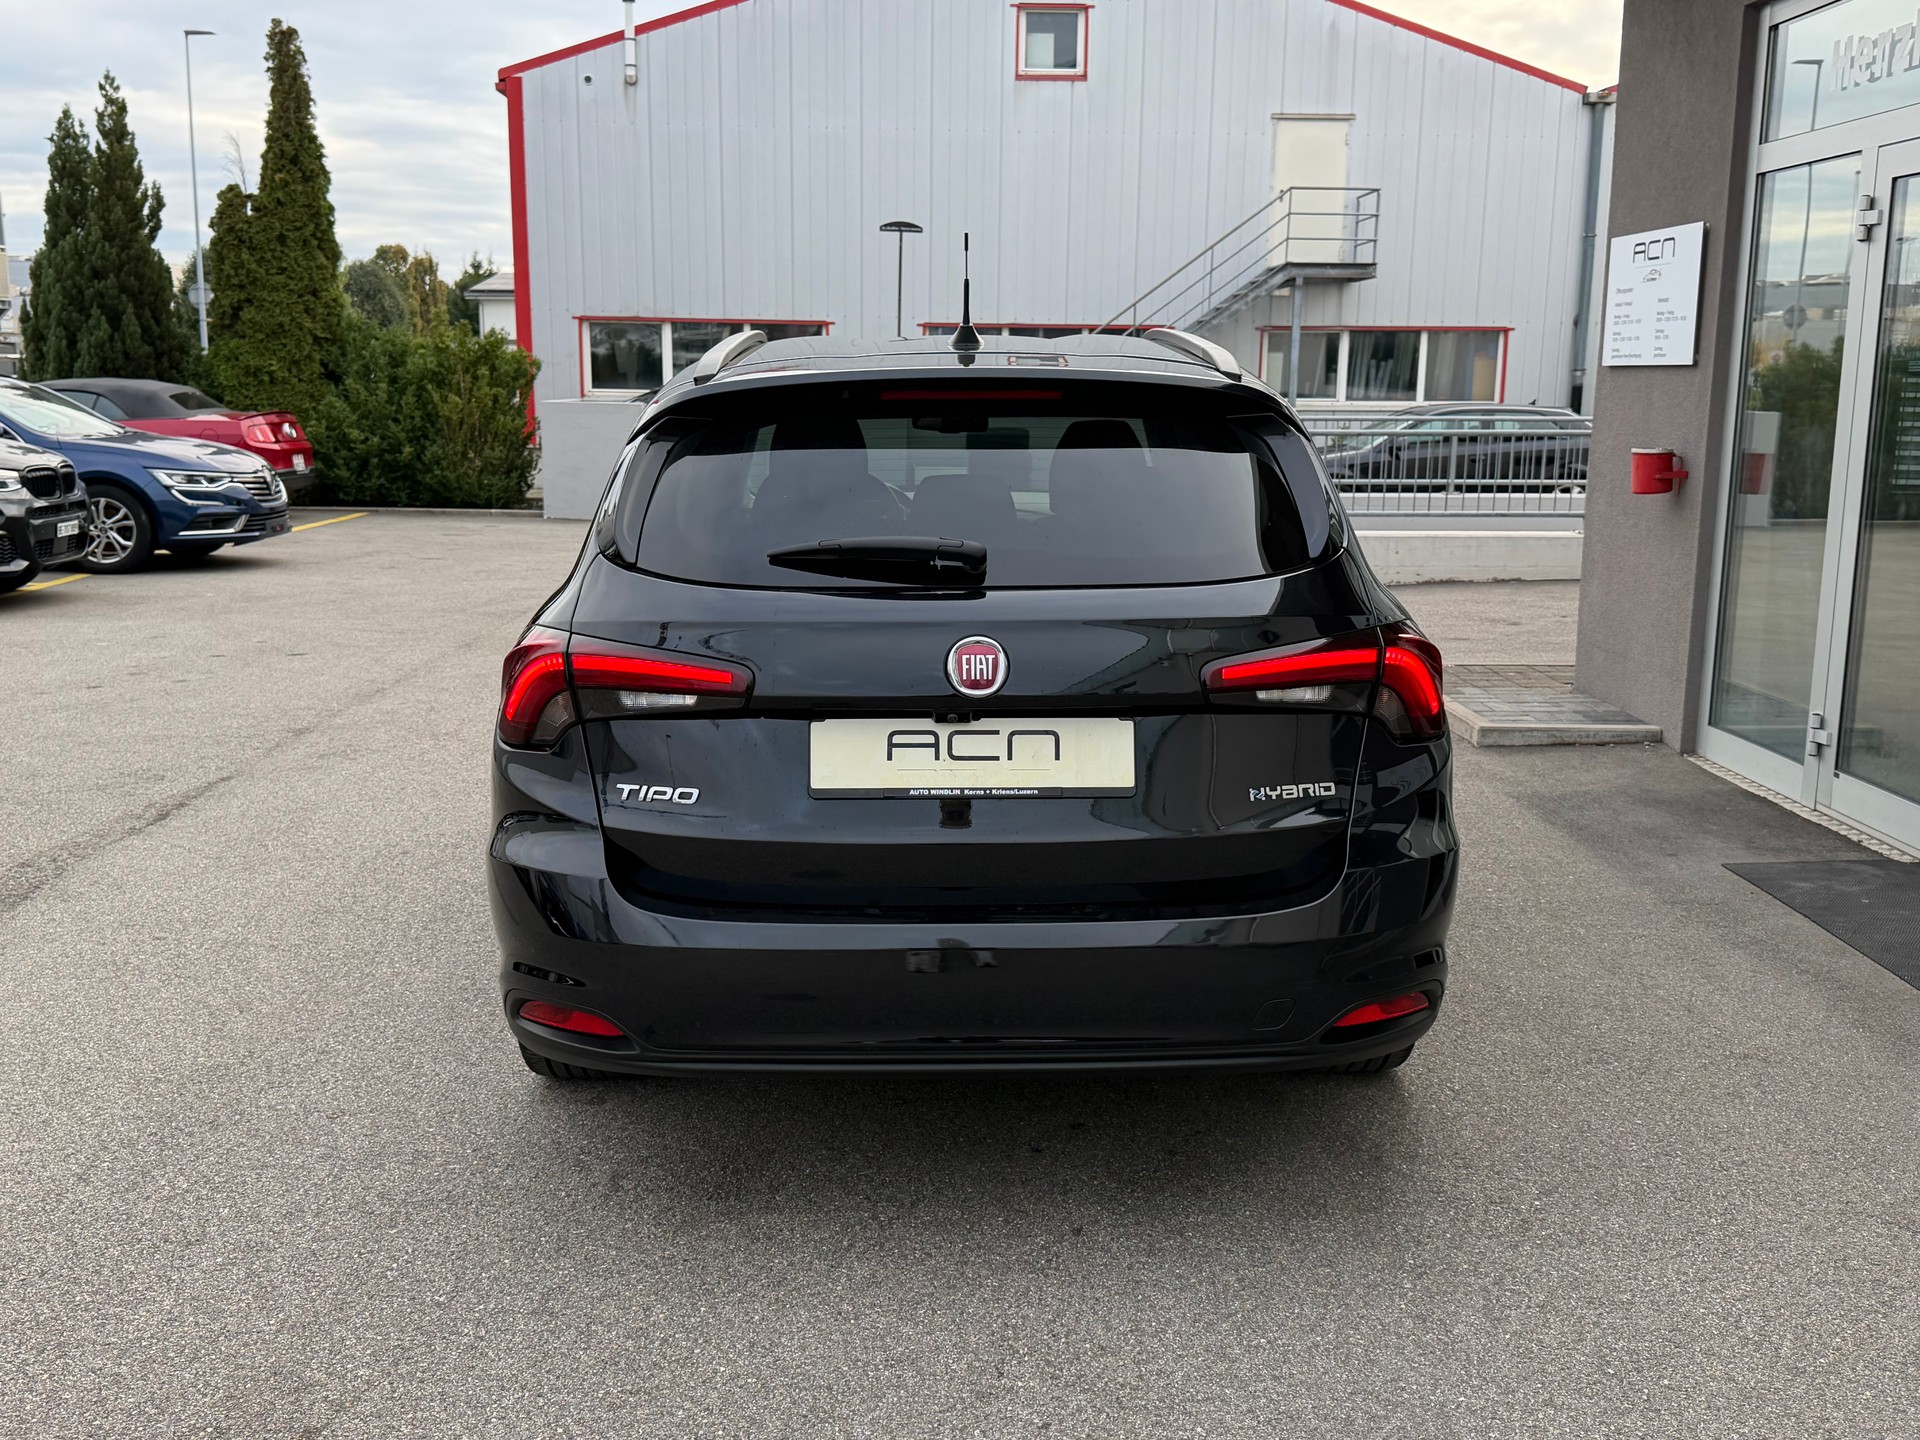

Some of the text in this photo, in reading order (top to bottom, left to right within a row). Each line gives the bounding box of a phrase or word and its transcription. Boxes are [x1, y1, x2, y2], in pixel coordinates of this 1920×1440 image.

[961, 654, 996, 680] FIAT
[616, 783, 700, 805] TIPO
[909, 788, 929, 796] AUTO
[930, 788, 960, 796] WINDLIN
[964, 788, 984, 796] Kerns
[1249, 782, 1336, 802] HYBRID
